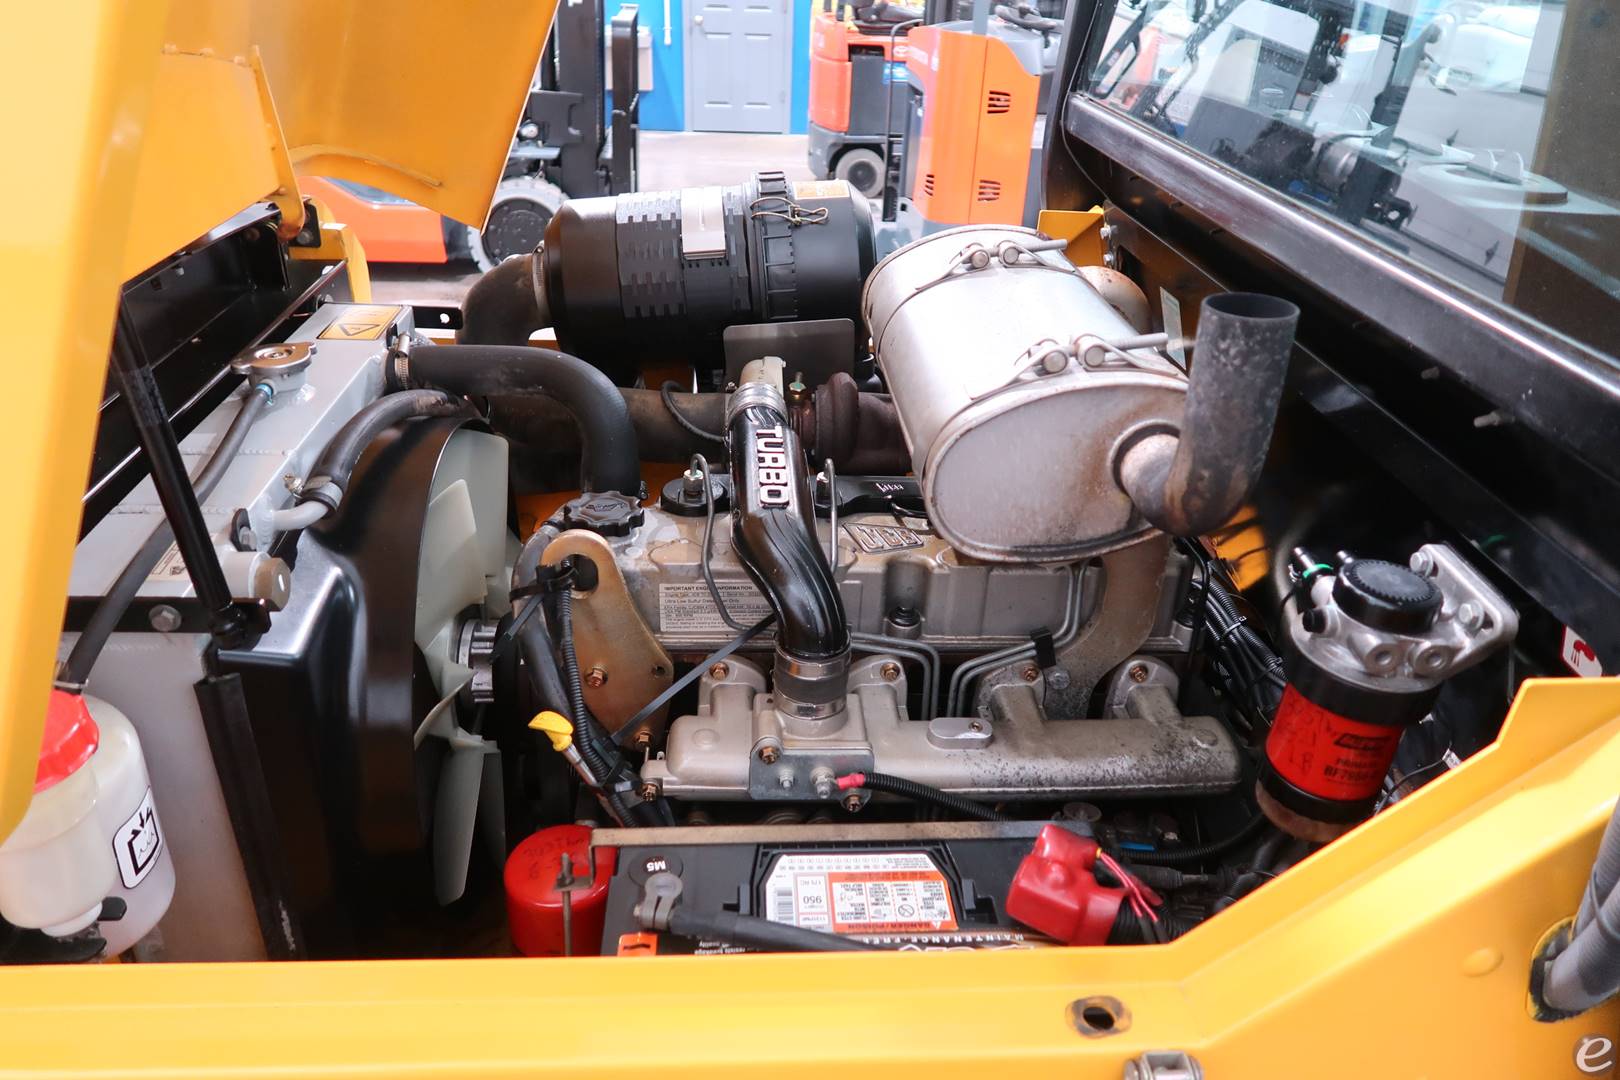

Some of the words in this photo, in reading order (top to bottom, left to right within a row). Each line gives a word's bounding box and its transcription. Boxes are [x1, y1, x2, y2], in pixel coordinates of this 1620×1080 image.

[755, 423, 790, 507] TURBO
[646, 860, 666, 872] M5
[802, 895, 823, 905] 950
